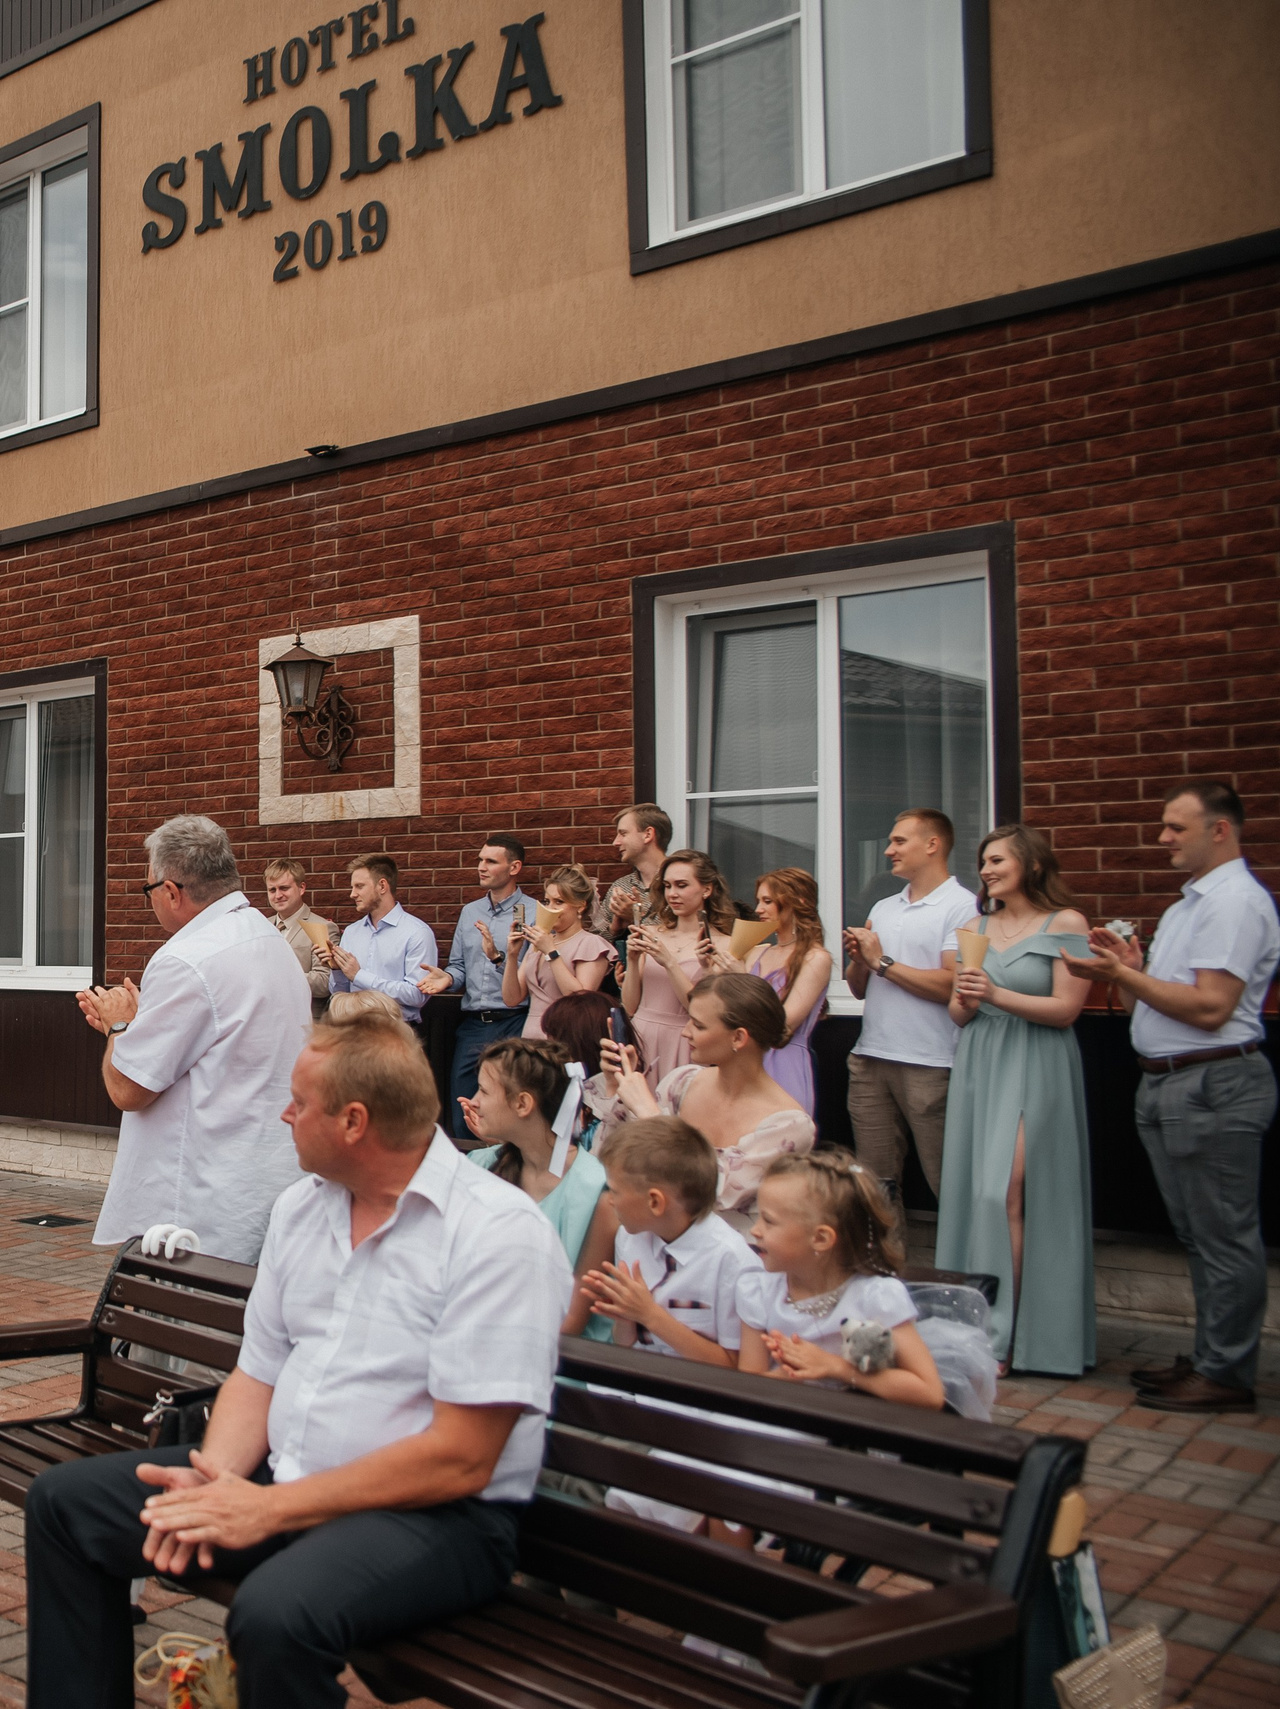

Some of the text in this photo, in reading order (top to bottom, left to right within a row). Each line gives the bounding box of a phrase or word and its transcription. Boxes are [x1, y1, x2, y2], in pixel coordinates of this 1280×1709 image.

[243, 0, 416, 105] HOTEL
[141, 12, 564, 255] SMOLKA
[273, 201, 389, 283] 2019
